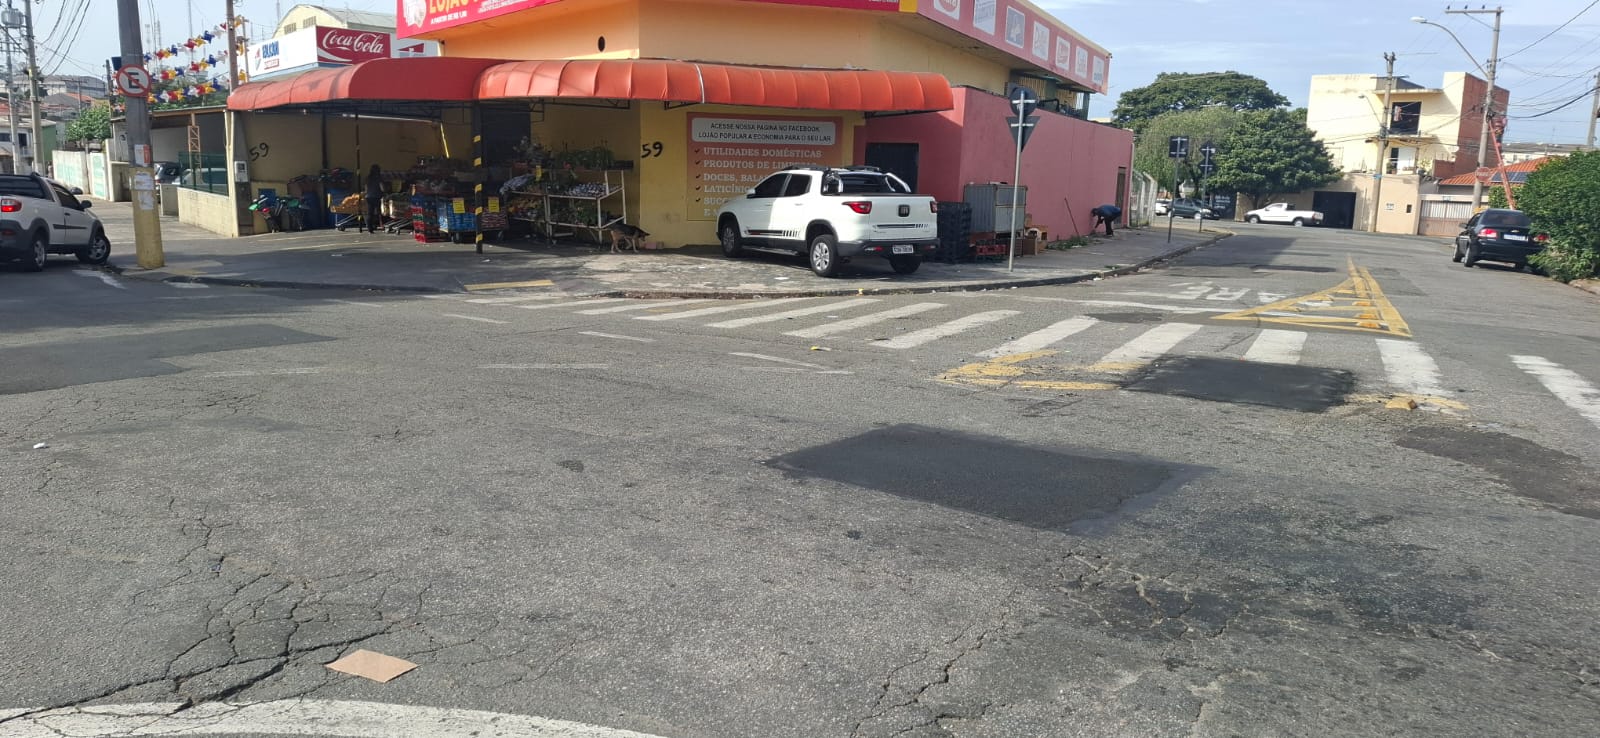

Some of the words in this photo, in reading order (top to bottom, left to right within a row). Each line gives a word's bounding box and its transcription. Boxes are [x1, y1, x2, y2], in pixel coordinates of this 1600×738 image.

[710, 122, 735, 130] ACESSE
[249, 142, 269, 162] 59
[641, 141, 663, 158] 59
[703, 147, 760, 157] UTILIDADES
[762, 147, 822, 158] DOMÉSTICAS
[703, 160, 754, 169] PRODUTOS
[757, 160, 769, 169] DE
[703, 173, 738, 183] DOCES,
